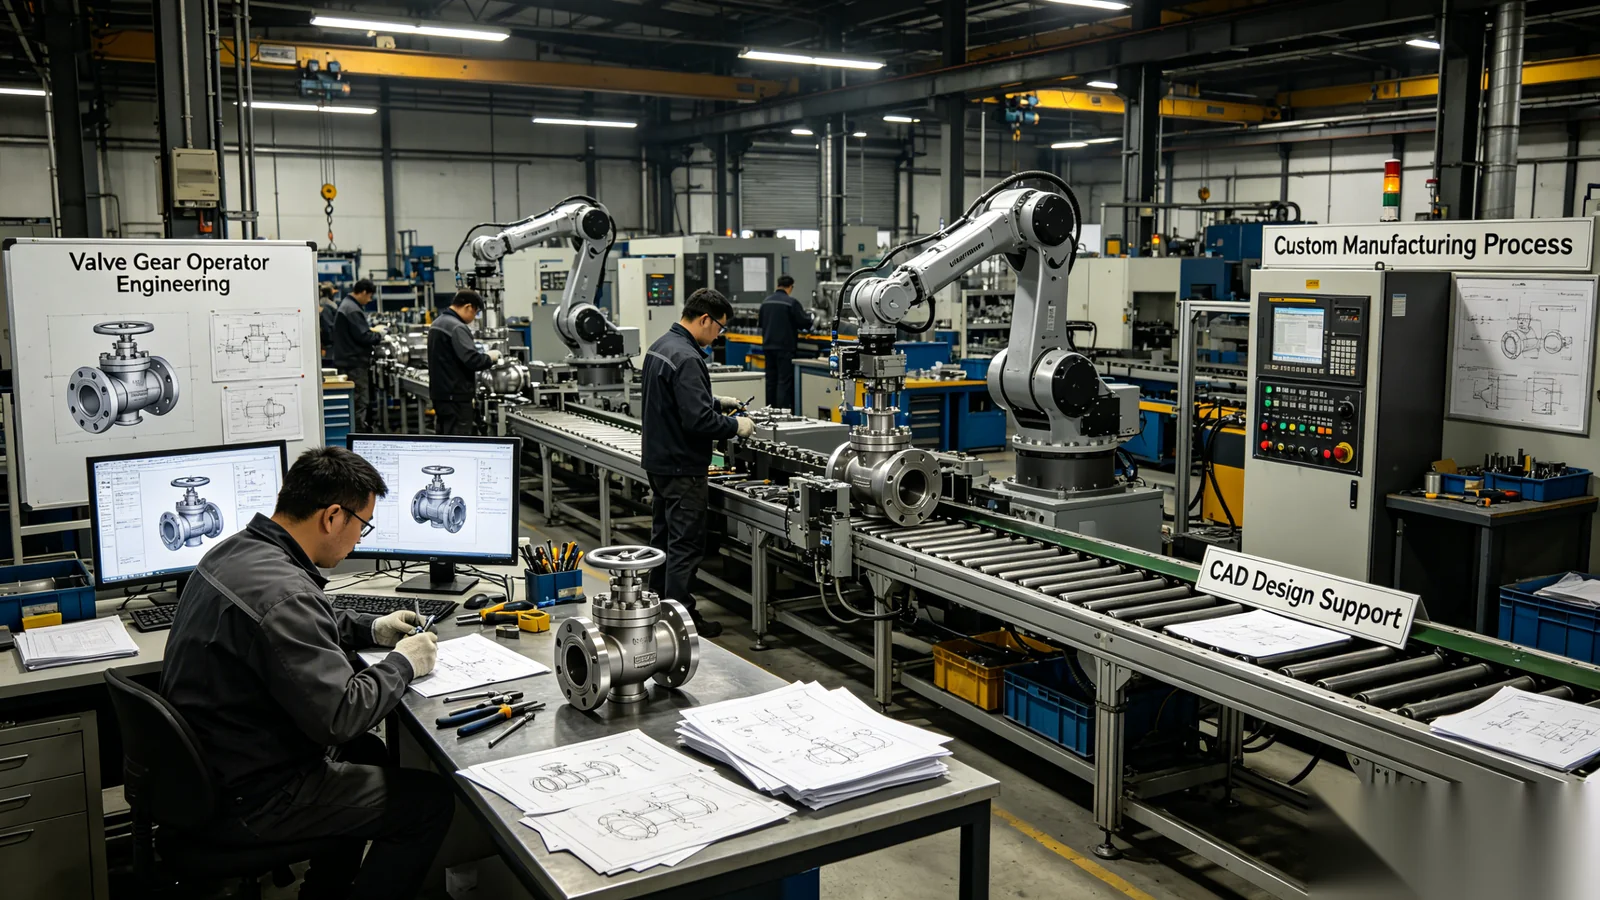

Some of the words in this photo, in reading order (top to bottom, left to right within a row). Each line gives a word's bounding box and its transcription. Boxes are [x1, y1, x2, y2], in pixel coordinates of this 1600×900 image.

[1274, 235, 1338, 256] Custom
[1342, 234, 1477, 260] Manufacturing
[1484, 232, 1573, 256] Process
[69, 252, 127, 271] Valve
[134, 253, 182, 271] Gear
[187, 253, 270, 274] Operator
[116, 275, 230, 296] Engineering
[1210, 560, 1249, 586] CAD
[1252, 570, 1314, 607] Design
[1319, 588, 1403, 629] Support
